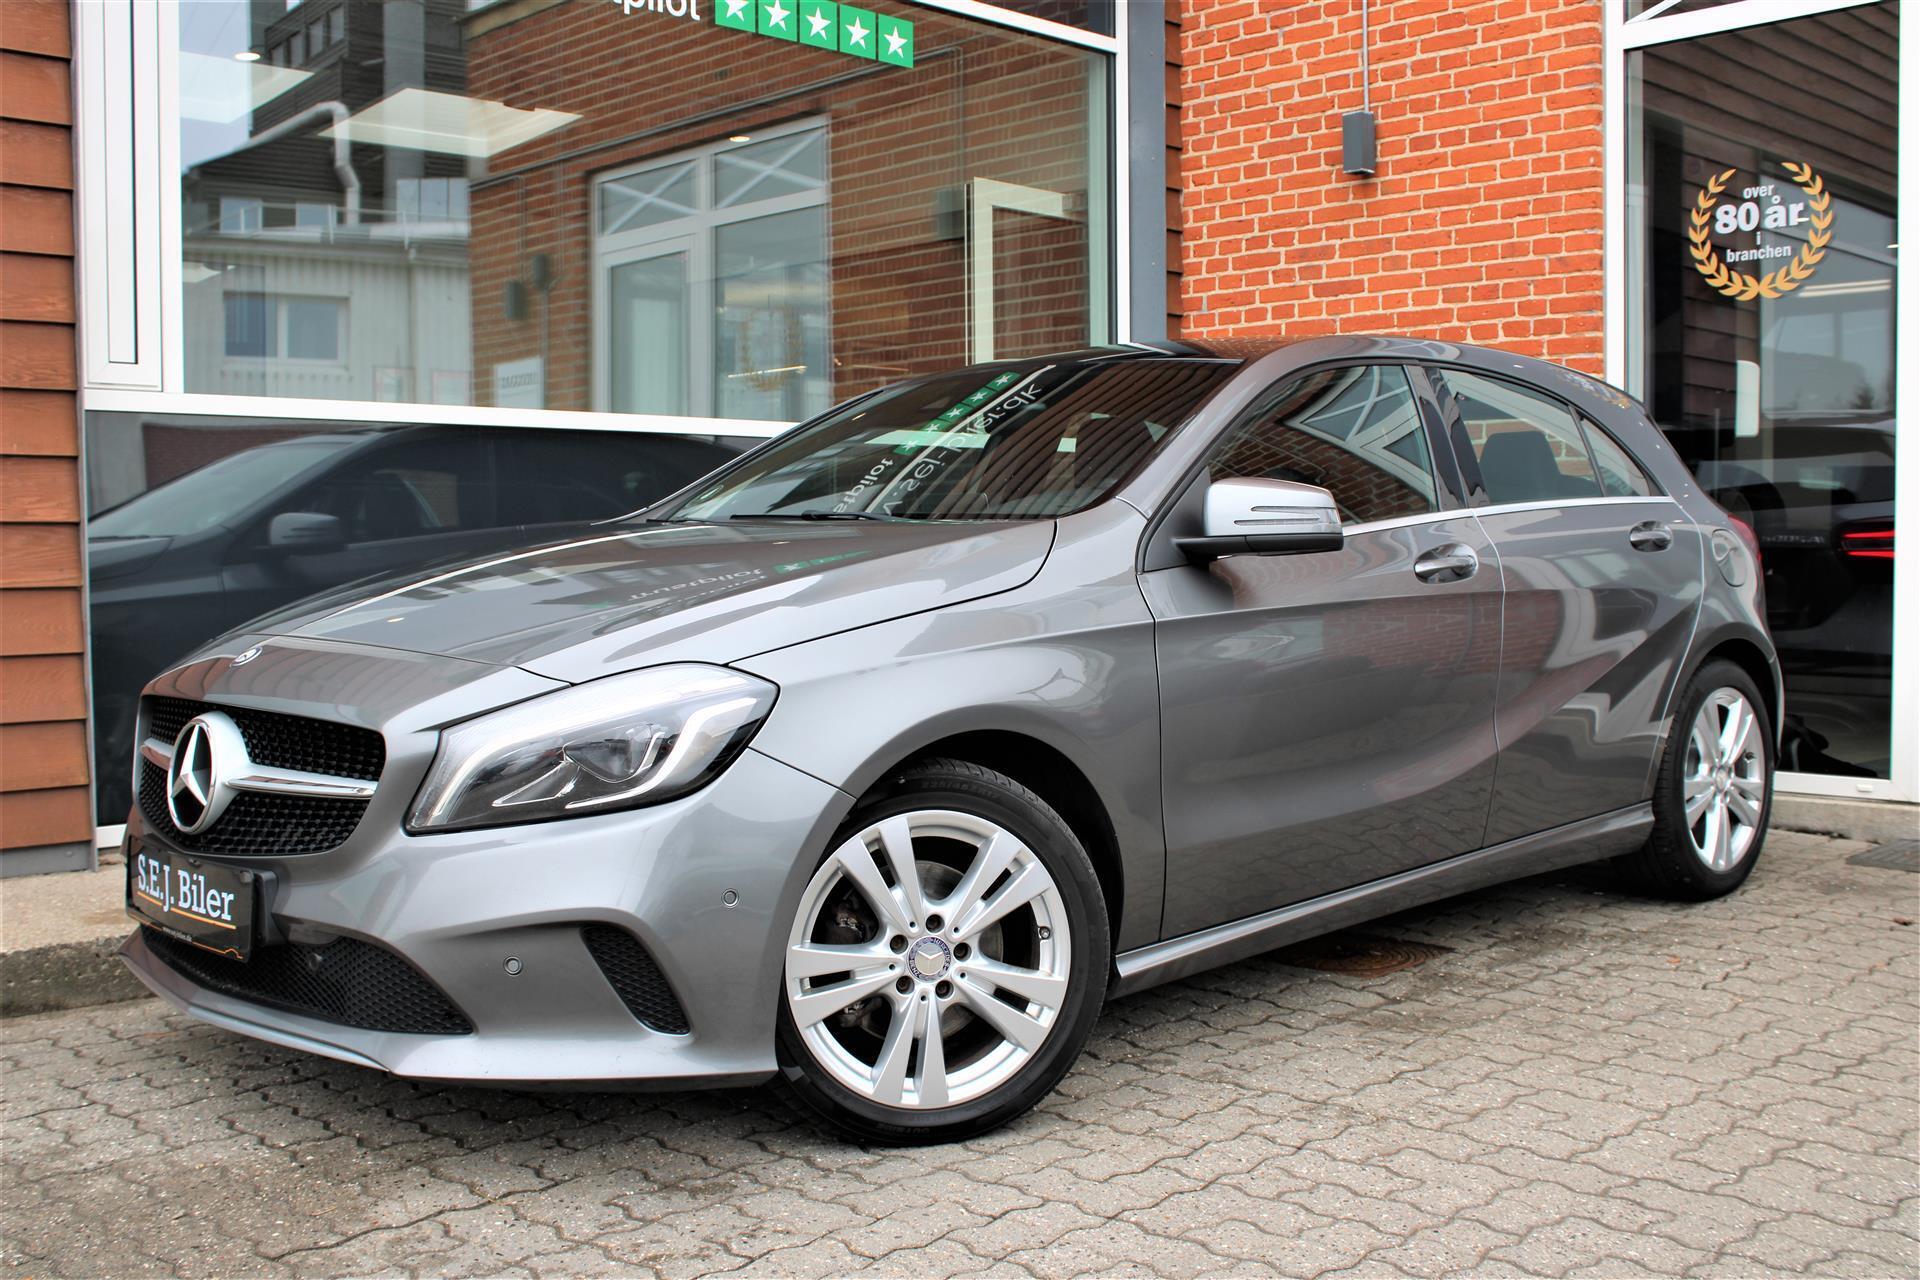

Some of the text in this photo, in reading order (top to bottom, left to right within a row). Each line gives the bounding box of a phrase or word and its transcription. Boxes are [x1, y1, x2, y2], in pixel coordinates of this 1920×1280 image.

[1743, 185, 1775, 199] over
[1715, 195, 1804, 234] 80 år
[1756, 231, 1761, 245] i
[1726, 245, 1791, 263] branchen
[138, 853, 234, 921] S.E.J. Biler
